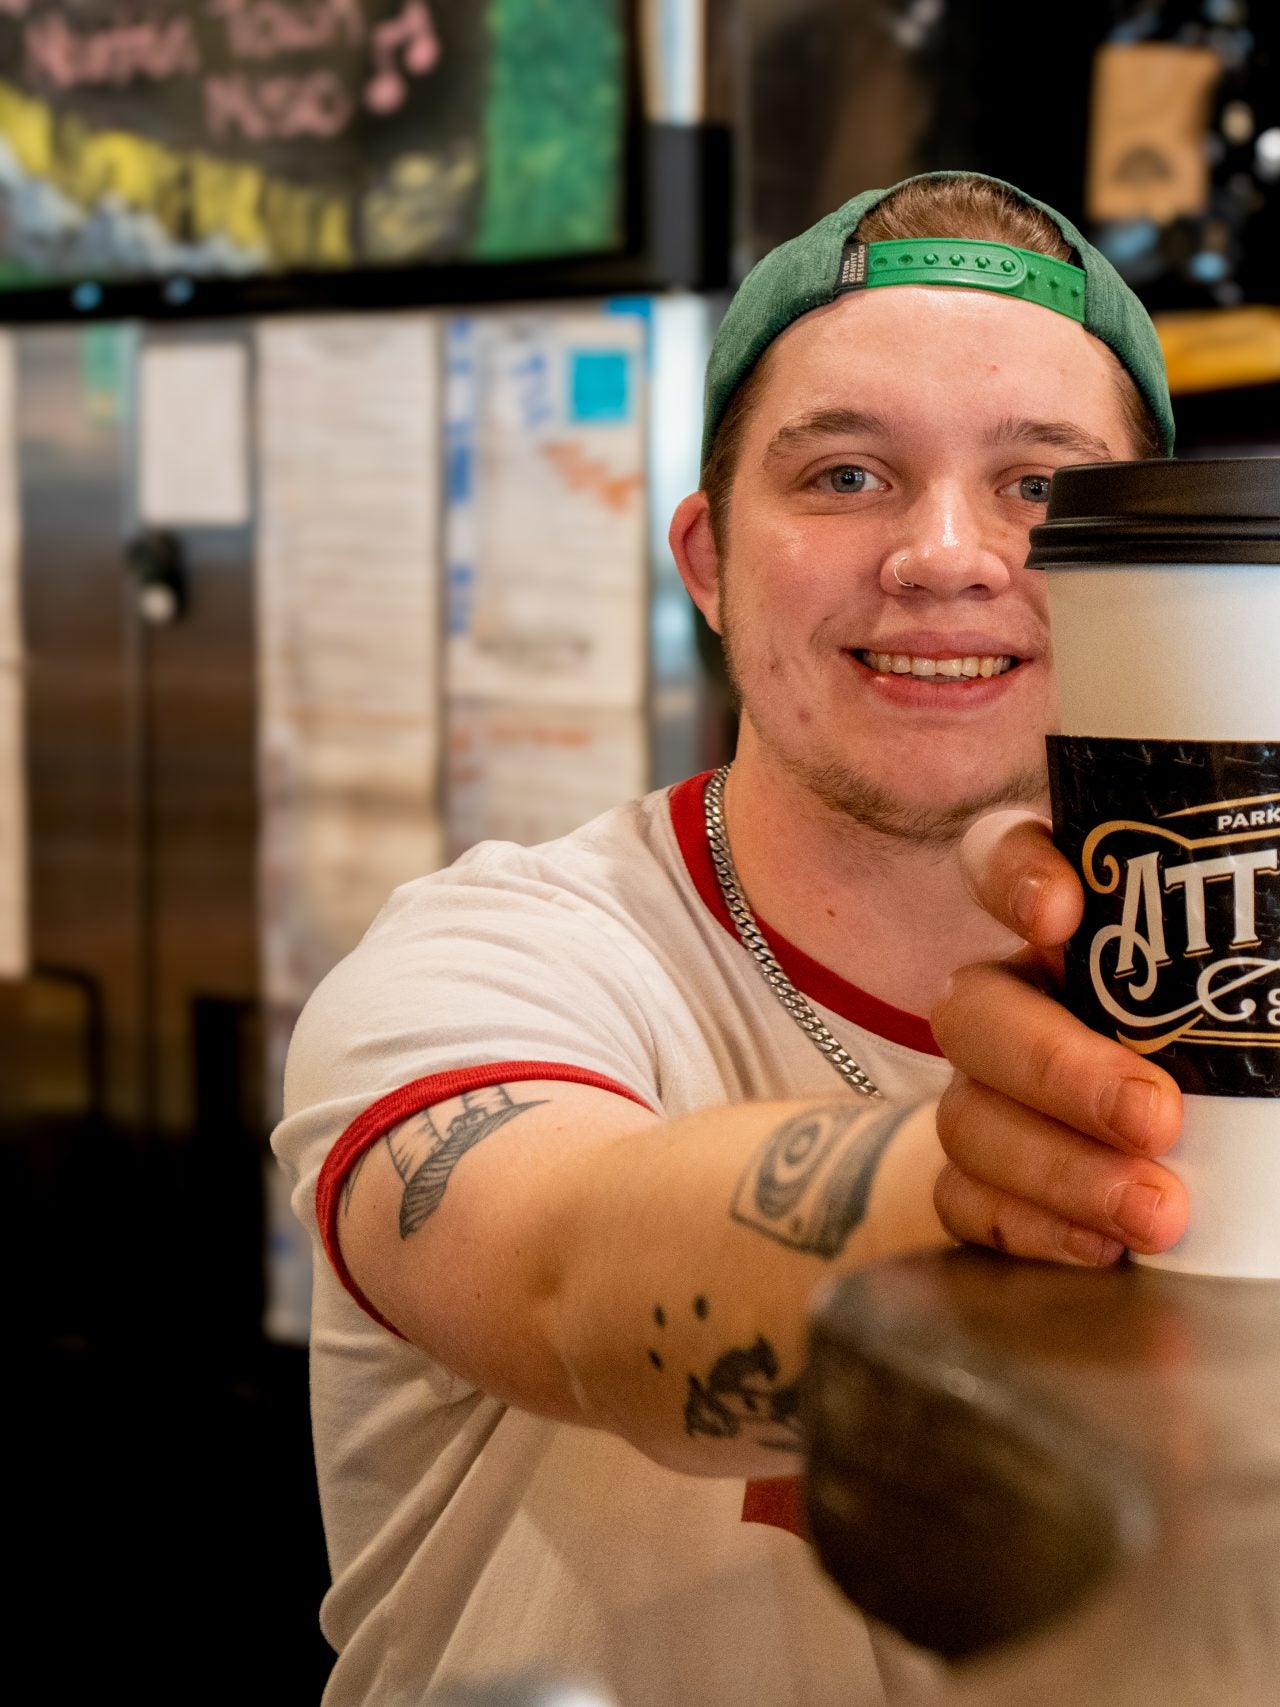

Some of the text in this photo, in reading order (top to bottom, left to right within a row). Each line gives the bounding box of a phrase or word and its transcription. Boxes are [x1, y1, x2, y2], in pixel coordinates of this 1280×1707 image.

[842, 260, 850, 283] TETON
[849, 252, 857, 282] GRAVITY
[857, 244, 865, 281] RESEARCH
